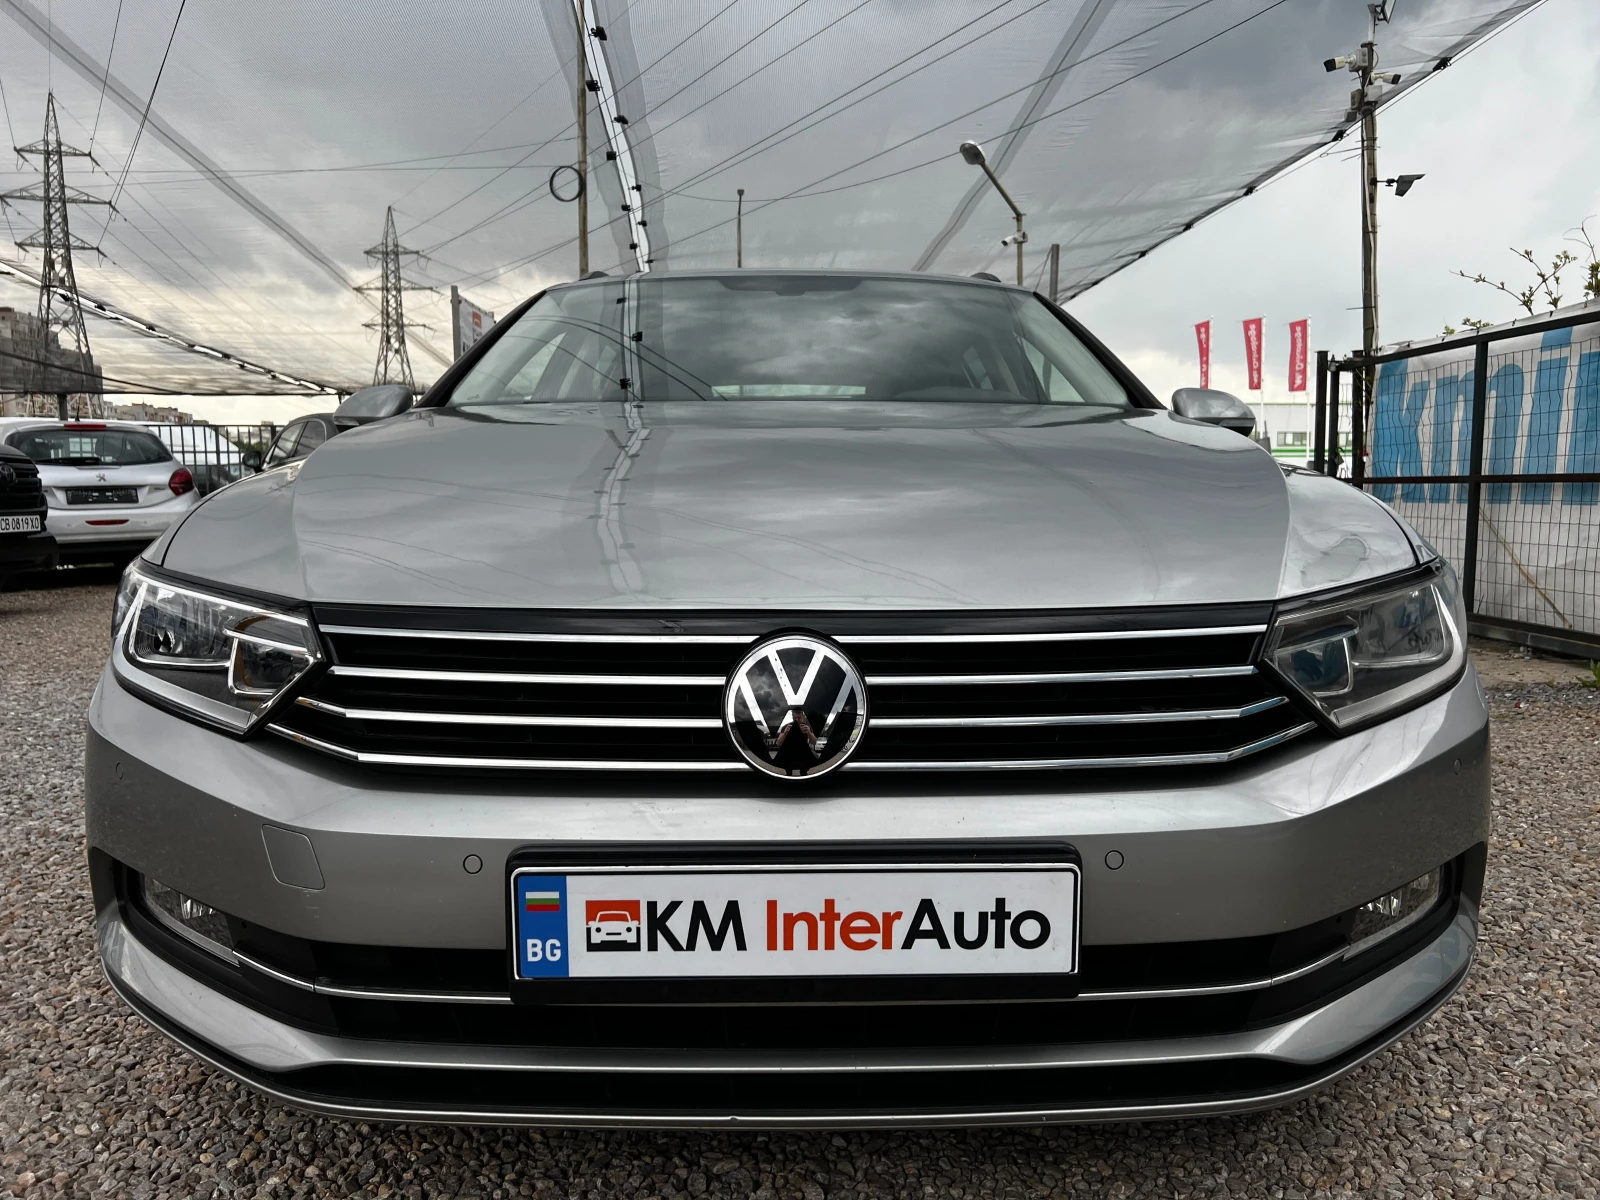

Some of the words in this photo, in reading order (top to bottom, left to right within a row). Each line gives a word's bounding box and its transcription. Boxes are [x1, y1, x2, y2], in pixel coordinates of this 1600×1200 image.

[647, 900, 747, 952] KM
[766, 898, 1051, 951] InterAuto
[526, 939, 562, 962] BG
